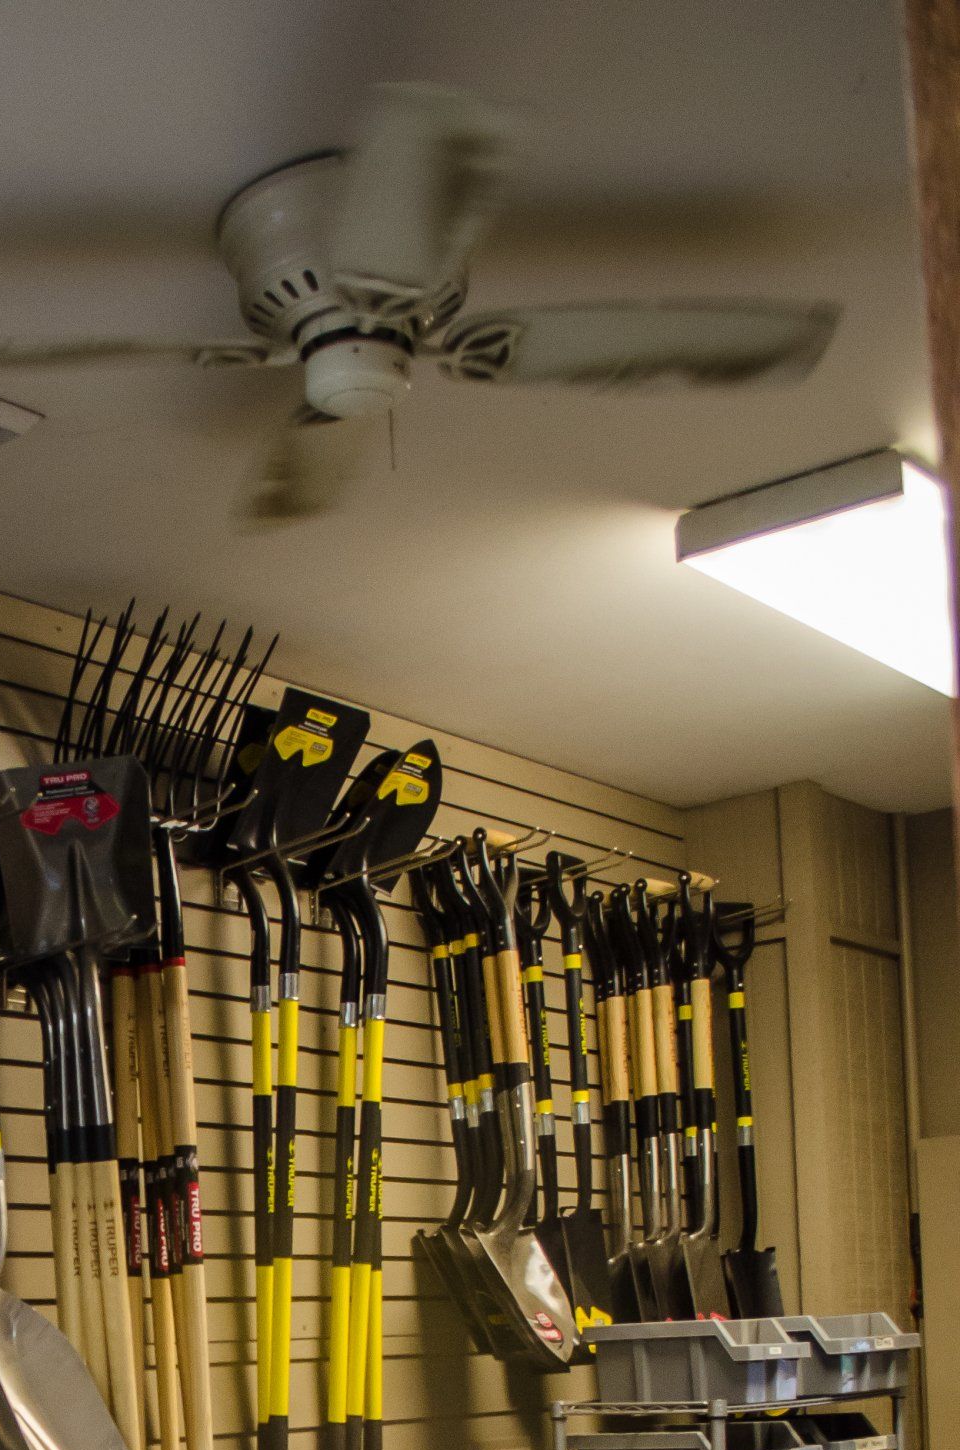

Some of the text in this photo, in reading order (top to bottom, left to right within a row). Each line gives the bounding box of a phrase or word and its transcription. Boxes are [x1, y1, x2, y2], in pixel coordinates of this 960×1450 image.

[105, 1218, 119, 1278] TRUPER
[190, 1188, 202, 1252] TRU PRO
